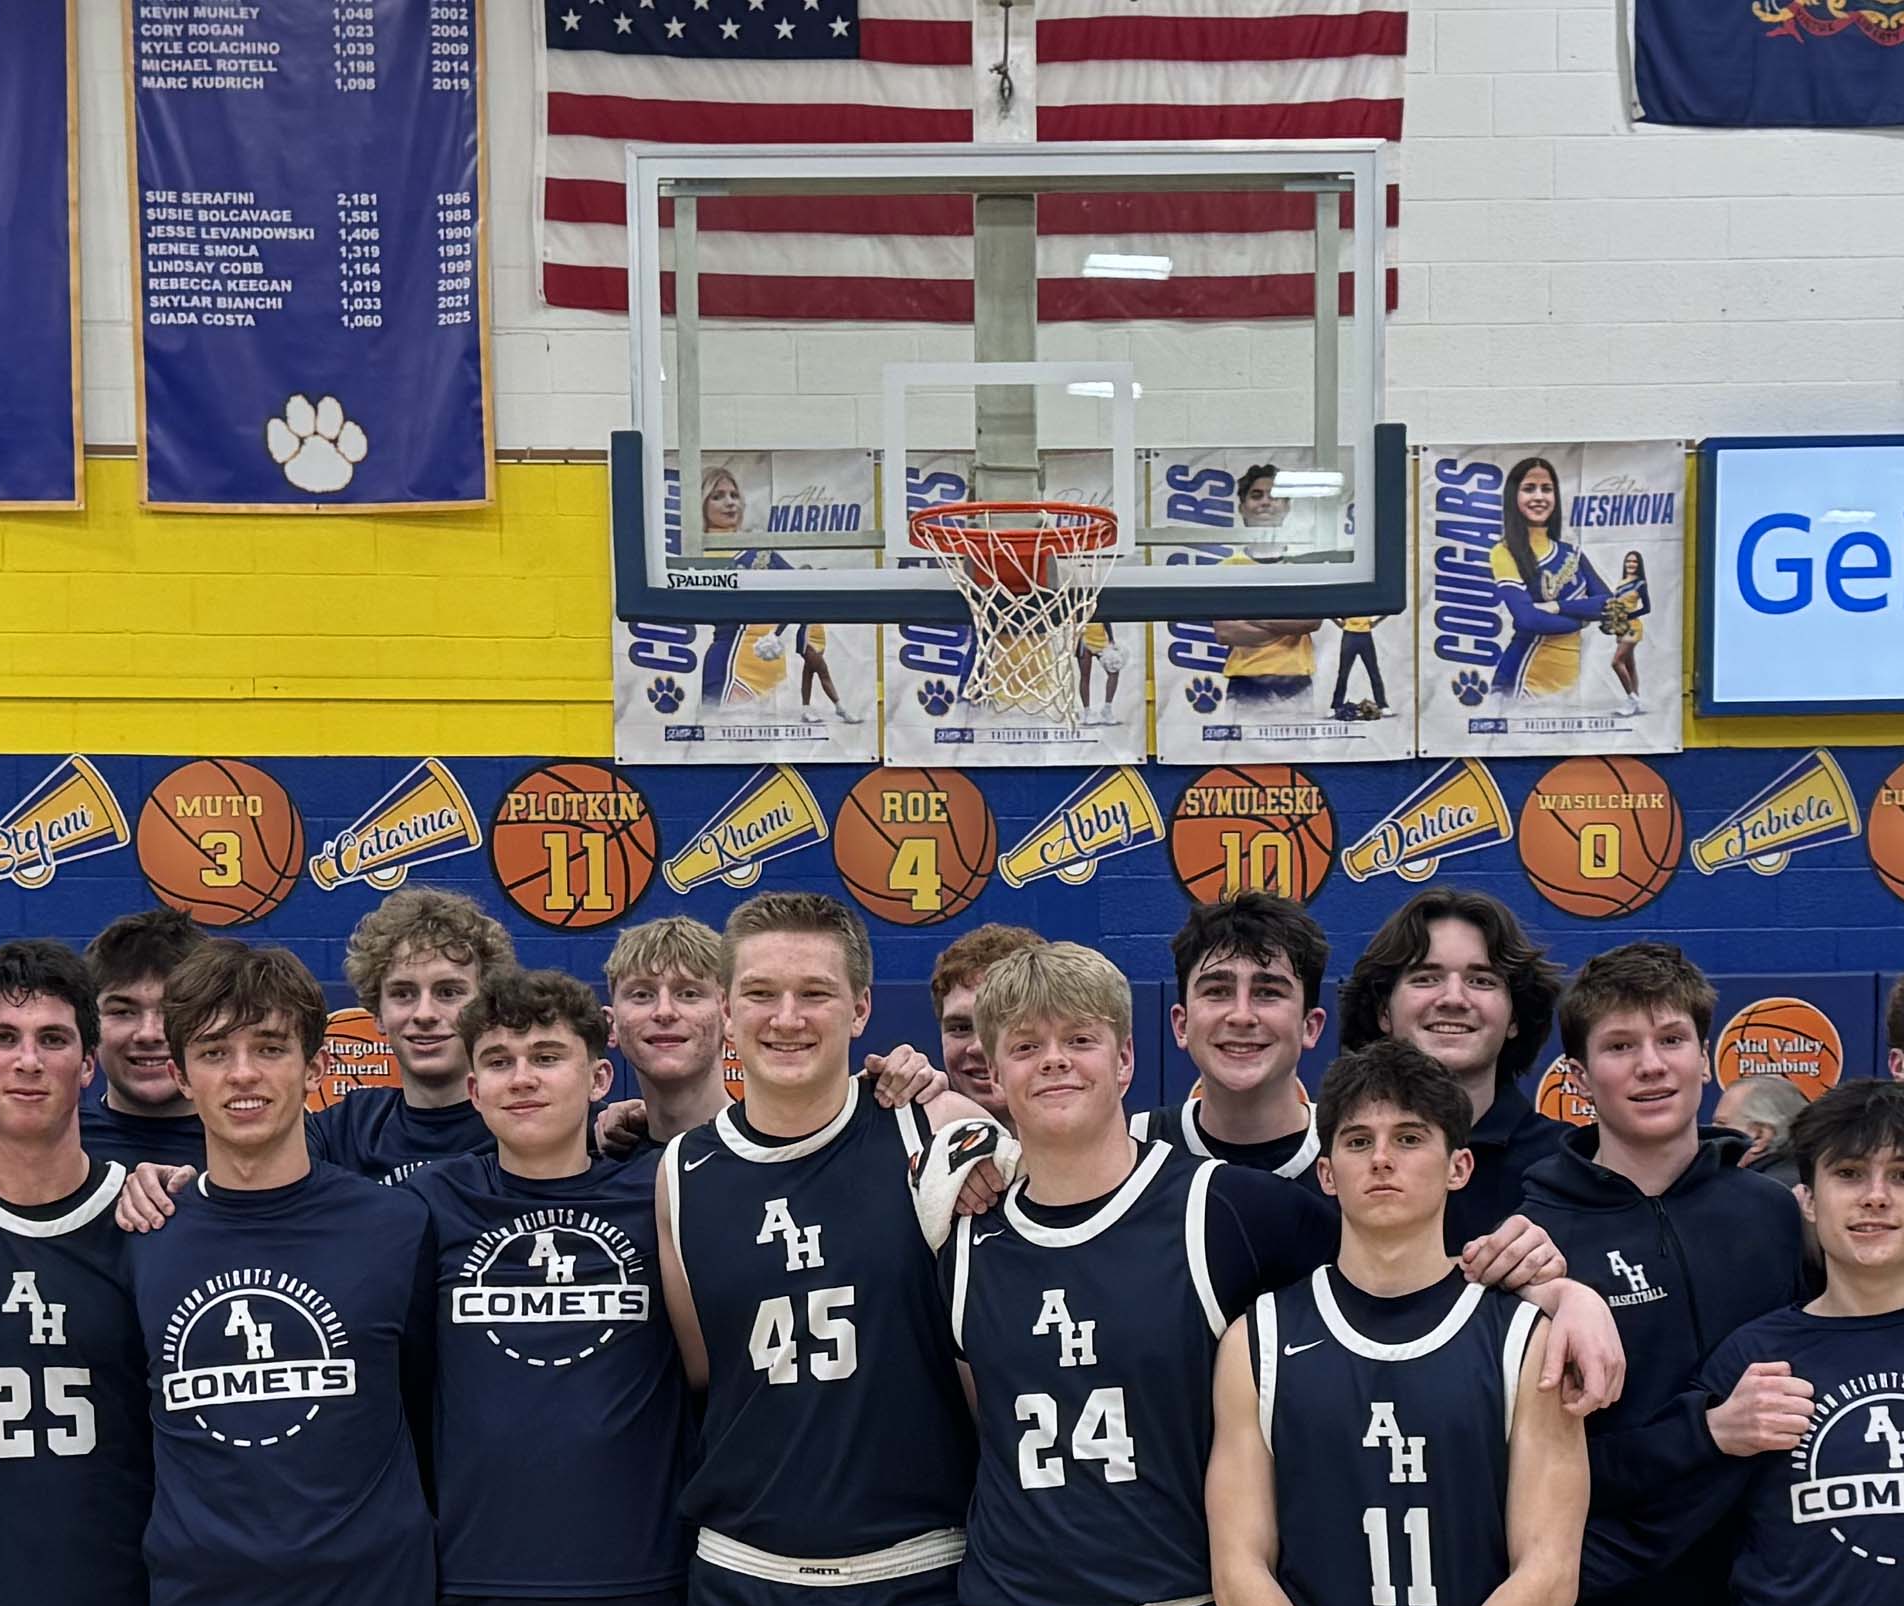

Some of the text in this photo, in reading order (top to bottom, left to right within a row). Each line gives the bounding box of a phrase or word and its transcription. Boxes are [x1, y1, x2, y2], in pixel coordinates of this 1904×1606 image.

[140, 7, 468, 22] KEVIN MUNLEY 1,048 2002
[141, 24, 469, 40] CORY ROGAN 1,023 2004
[141, 42, 183, 54] KYLE
[187, 42, 280, 55] COLACHINO
[432, 43, 469, 55] 2009
[142, 59, 212, 72] MICHAEL
[216, 60, 277, 73] ROTELL
[432, 60, 469, 73] 2014
[142, 77, 188, 89] MARC
[193, 77, 264, 90] KUDRICH
[433, 77, 470, 90] 2019
[146, 191, 177, 203] SUE
[182, 191, 255, 205] SERAFINI
[337, 193, 377, 207] 2,181
[146, 208, 193, 221] SUSIE
[198, 209, 292, 222] BOLCAVAGE
[338, 211, 378, 225] 1,581
[147, 226, 471, 243] JESSE LEVANDOWSKI 1,406 1990
[148, 243, 199, 256] RENEE
[204, 244, 259, 258] SMOLA
[150, 294, 470, 313] SKYLAR BIANCHI 1,033 2021
[150, 311, 471, 330] GIADA COSTA 1,060 2025
[767, 503, 861, 532] MARINO
[1569, 493, 1675, 528] NESHKOVA
[1433, 457, 1505, 668] COUGARS
[667, 573, 739, 589] SPALDING
[175, 794, 264, 818] MUTO
[507, 792, 640, 822] PLOTKIN
[881, 790, 949, 823] ROE
[1185, 786, 1321, 817] SYMULESKI
[1537, 791, 1664, 812] WASILCHAK
[333, 803, 459, 879] Catarina
[698, 798, 795, 866] Khami
[1039, 795, 1132, 867] Abby
[1372, 800, 1478, 869] Dahlia
[1724, 794, 1835, 860] Fabiola
[199, 831, 243, 888] 3
[1578, 823, 1621, 879] 0
[542, 831, 613, 911] 11
[888, 838, 943, 911] 4
[1218, 831, 1293, 903] 10
[1734, 1038, 1825, 1057] Mid Valley
[1738, 1057, 1820, 1078] Plumbing
[459, 1290, 644, 1316] COMETS
[748, 1286, 857, 1384] 45
[168, 1365, 348, 1403] COMETS
[1015, 1387, 1135, 1490] 24
